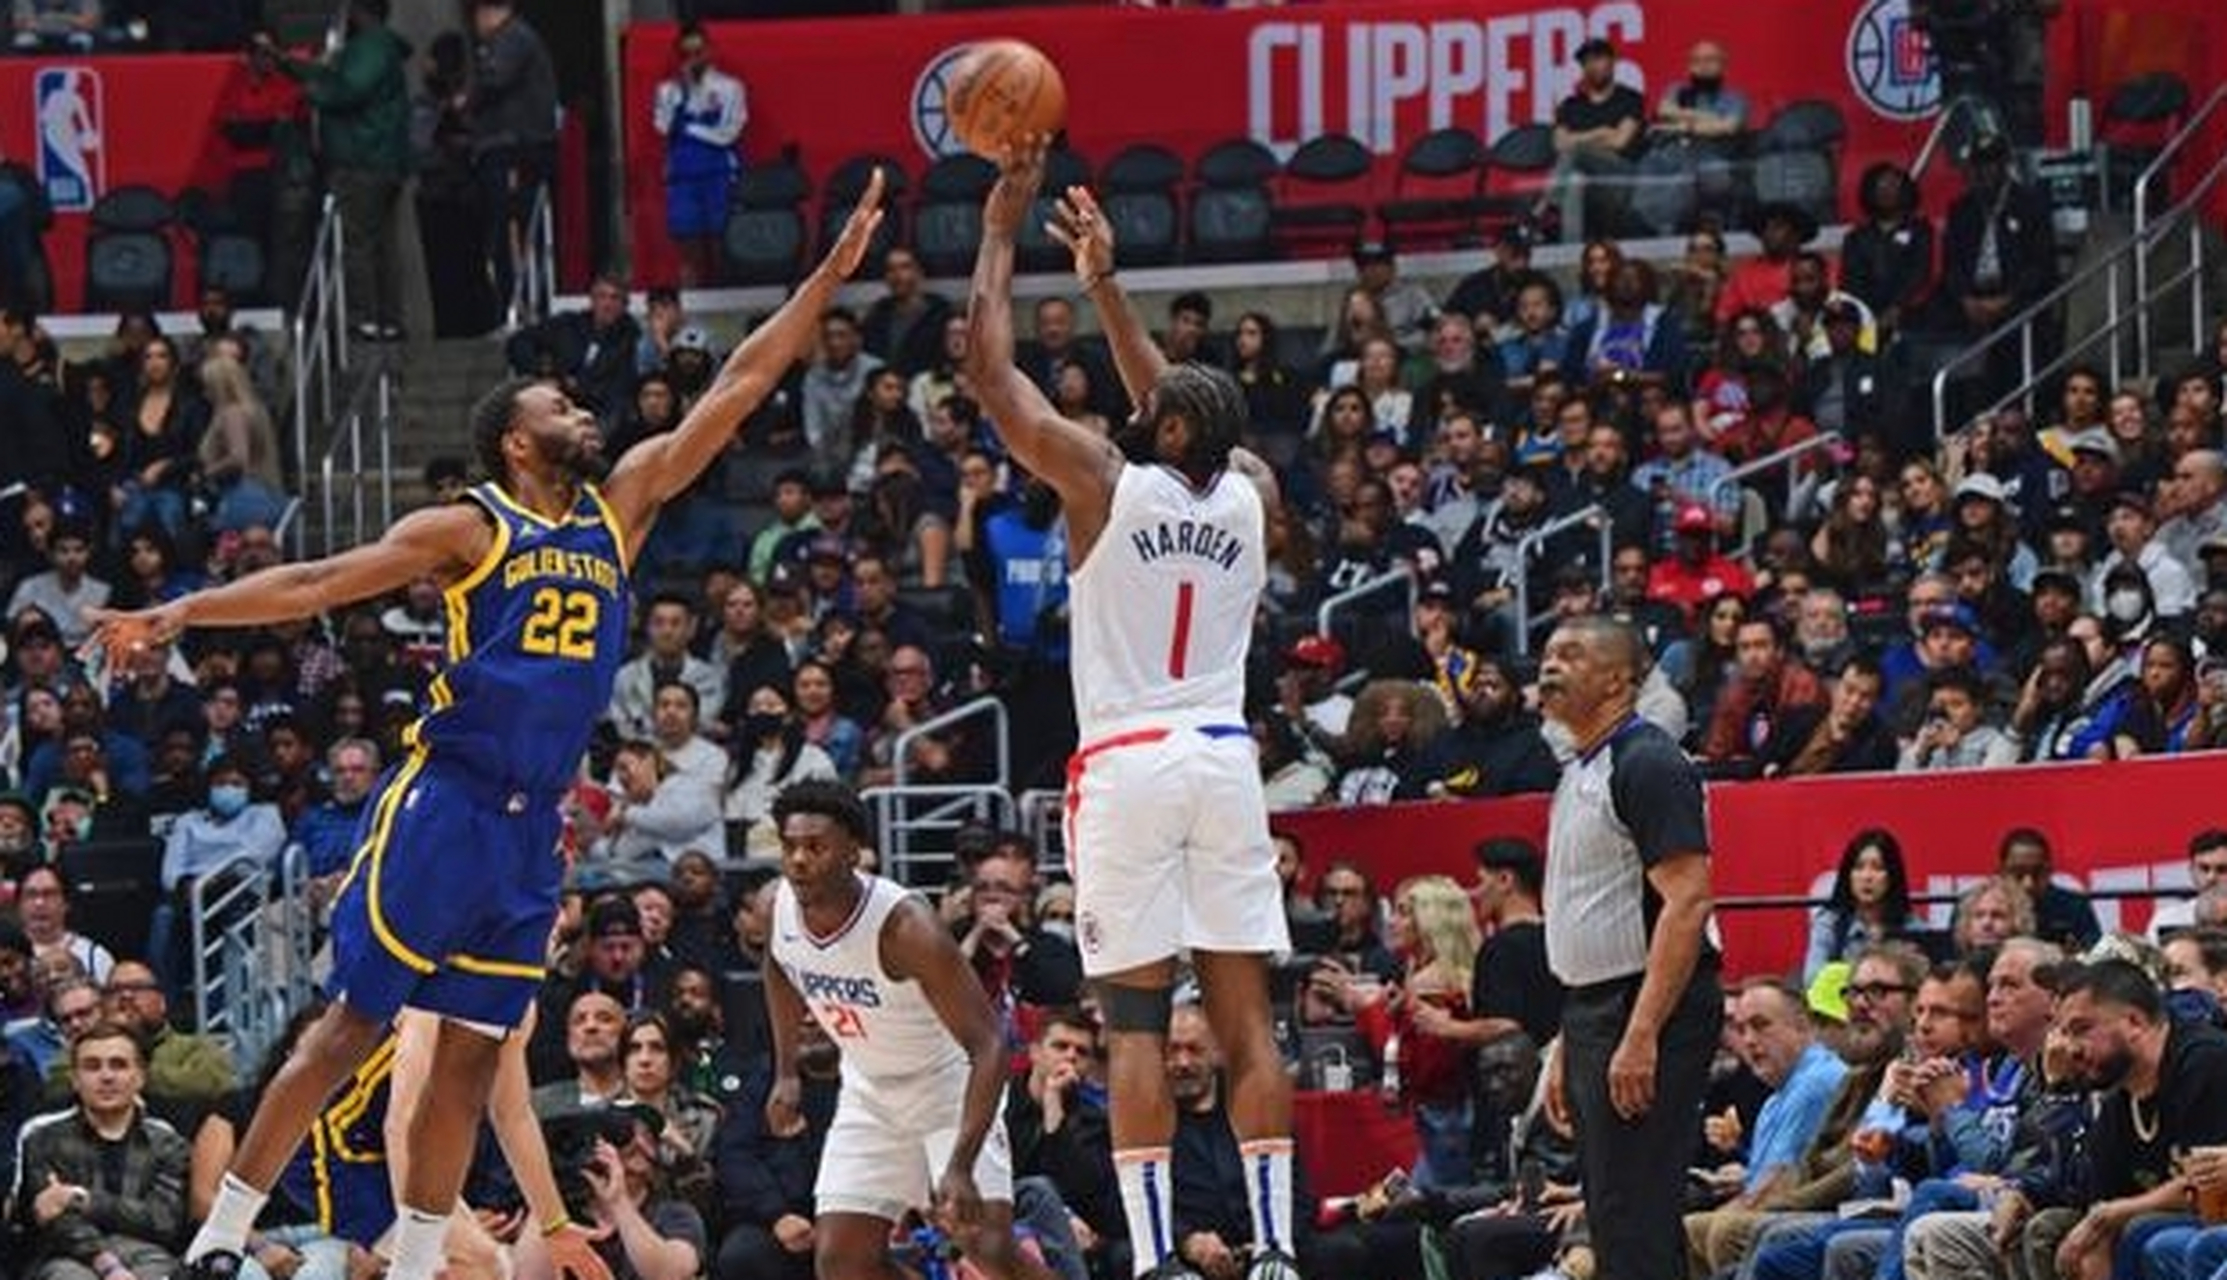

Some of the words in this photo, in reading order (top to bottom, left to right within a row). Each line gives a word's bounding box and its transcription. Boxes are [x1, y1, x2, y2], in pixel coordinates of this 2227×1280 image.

[1132, 520, 1243, 571] HARDEN
[521, 587, 599, 661] 22
[1168, 580, 1193, 681] 1
[823, 1003, 869, 1040] 21
